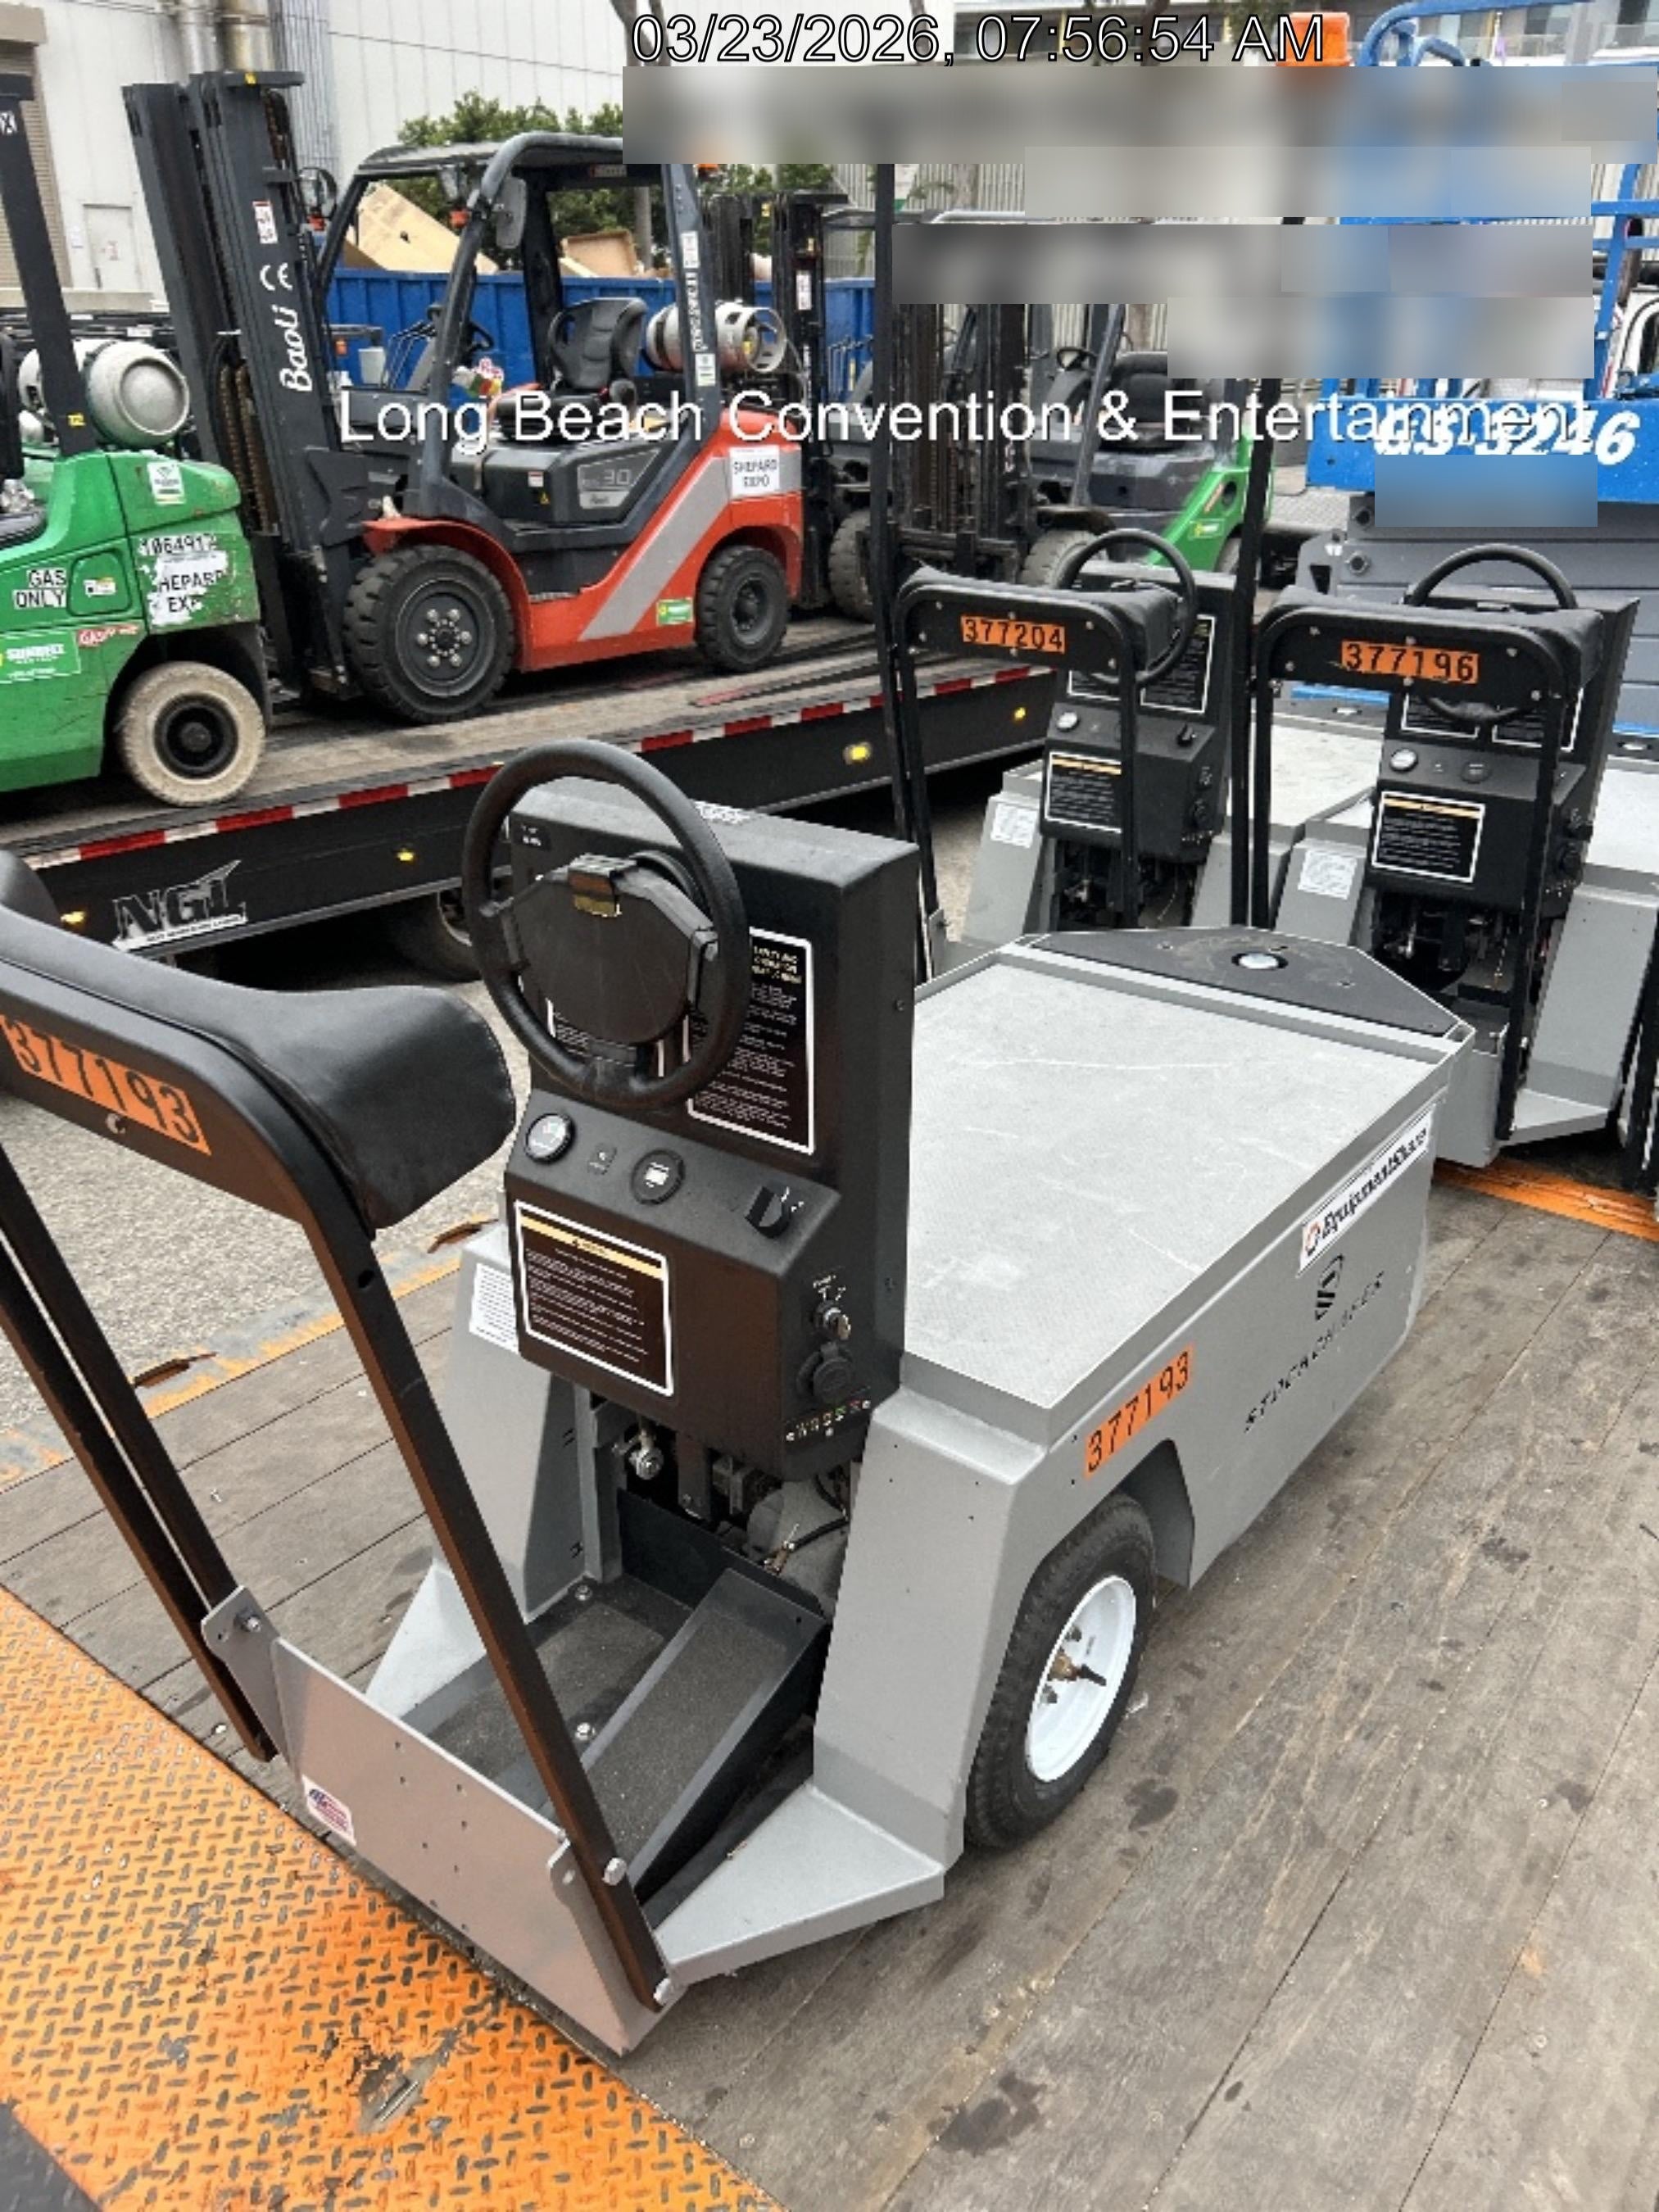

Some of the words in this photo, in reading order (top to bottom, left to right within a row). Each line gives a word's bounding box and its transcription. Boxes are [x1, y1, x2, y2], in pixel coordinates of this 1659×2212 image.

[272, 304, 312, 391] Baoli
[604, 469, 631, 485] 30
[29, 569, 66, 587] GAS
[16, 590, 65, 608] ONLY
[963, 618, 1063, 652] 377204
[1345, 643, 1474, 682] 377196
[13, 1022, 200, 1144] 377193
[1086, 1350, 1190, 1474] 377193
